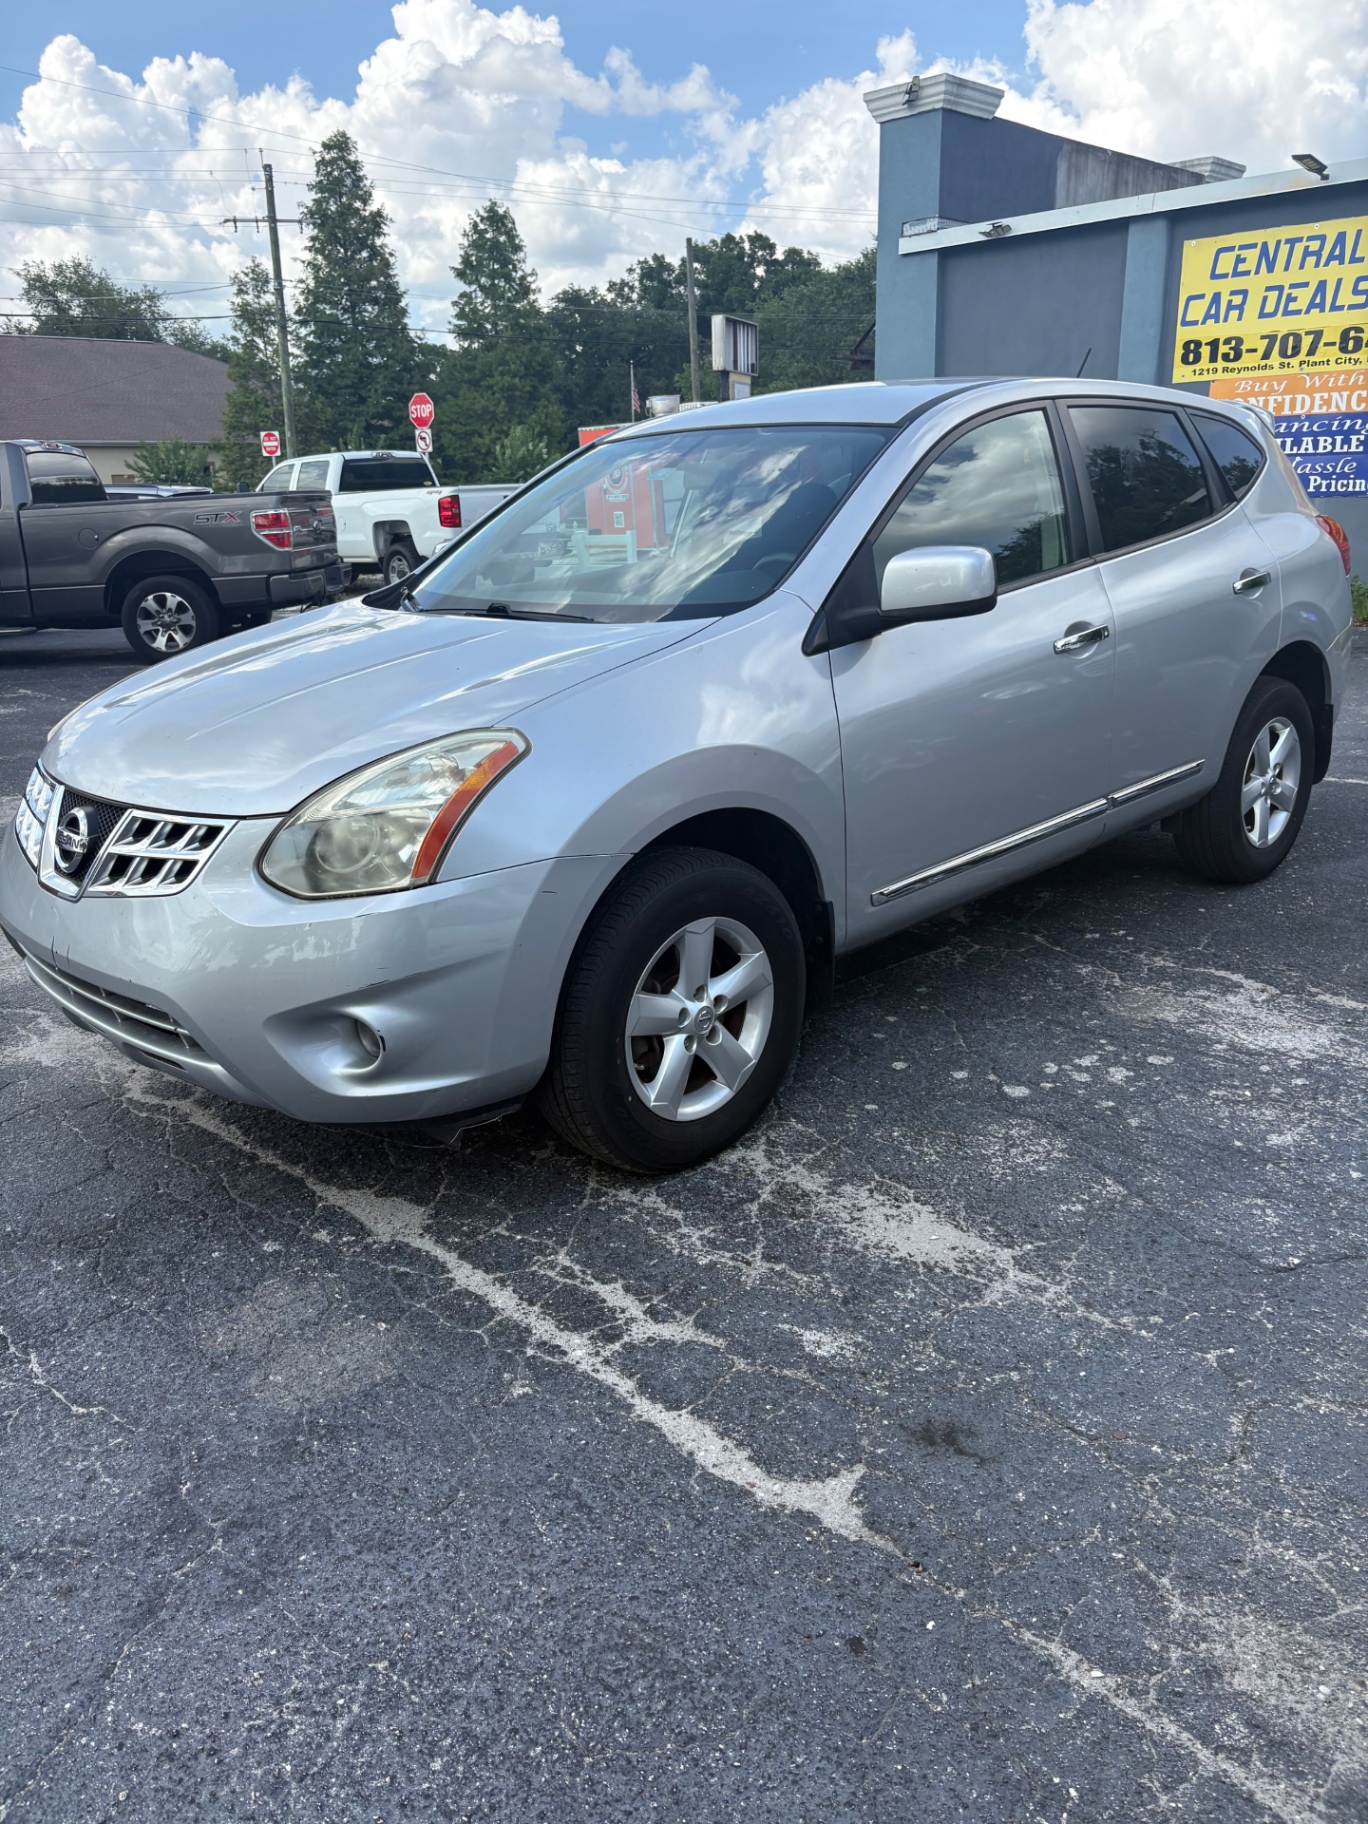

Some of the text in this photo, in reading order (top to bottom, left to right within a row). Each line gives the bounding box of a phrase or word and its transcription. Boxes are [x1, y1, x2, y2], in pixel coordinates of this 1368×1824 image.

[1209, 229, 1365, 280] CENTRAL
[1180, 275, 1368, 327] CAR DEALS
[1180, 326, 1368, 365] 813-707-6
[1191, 367, 1218, 376] 1219
[1222, 363, 1274, 374] Reynolds
[1278, 361, 1294, 370] St.
[1299, 358, 1331, 368] Plant
[1334, 356, 1362, 366] City,
[1234, 369, 1366, 396] Buy With
[411, 404, 432, 418] STOP
[1274, 415, 1368, 435] ancin
[1307, 474, 1368, 494] Pricin
[194, 511, 242, 525] STX
